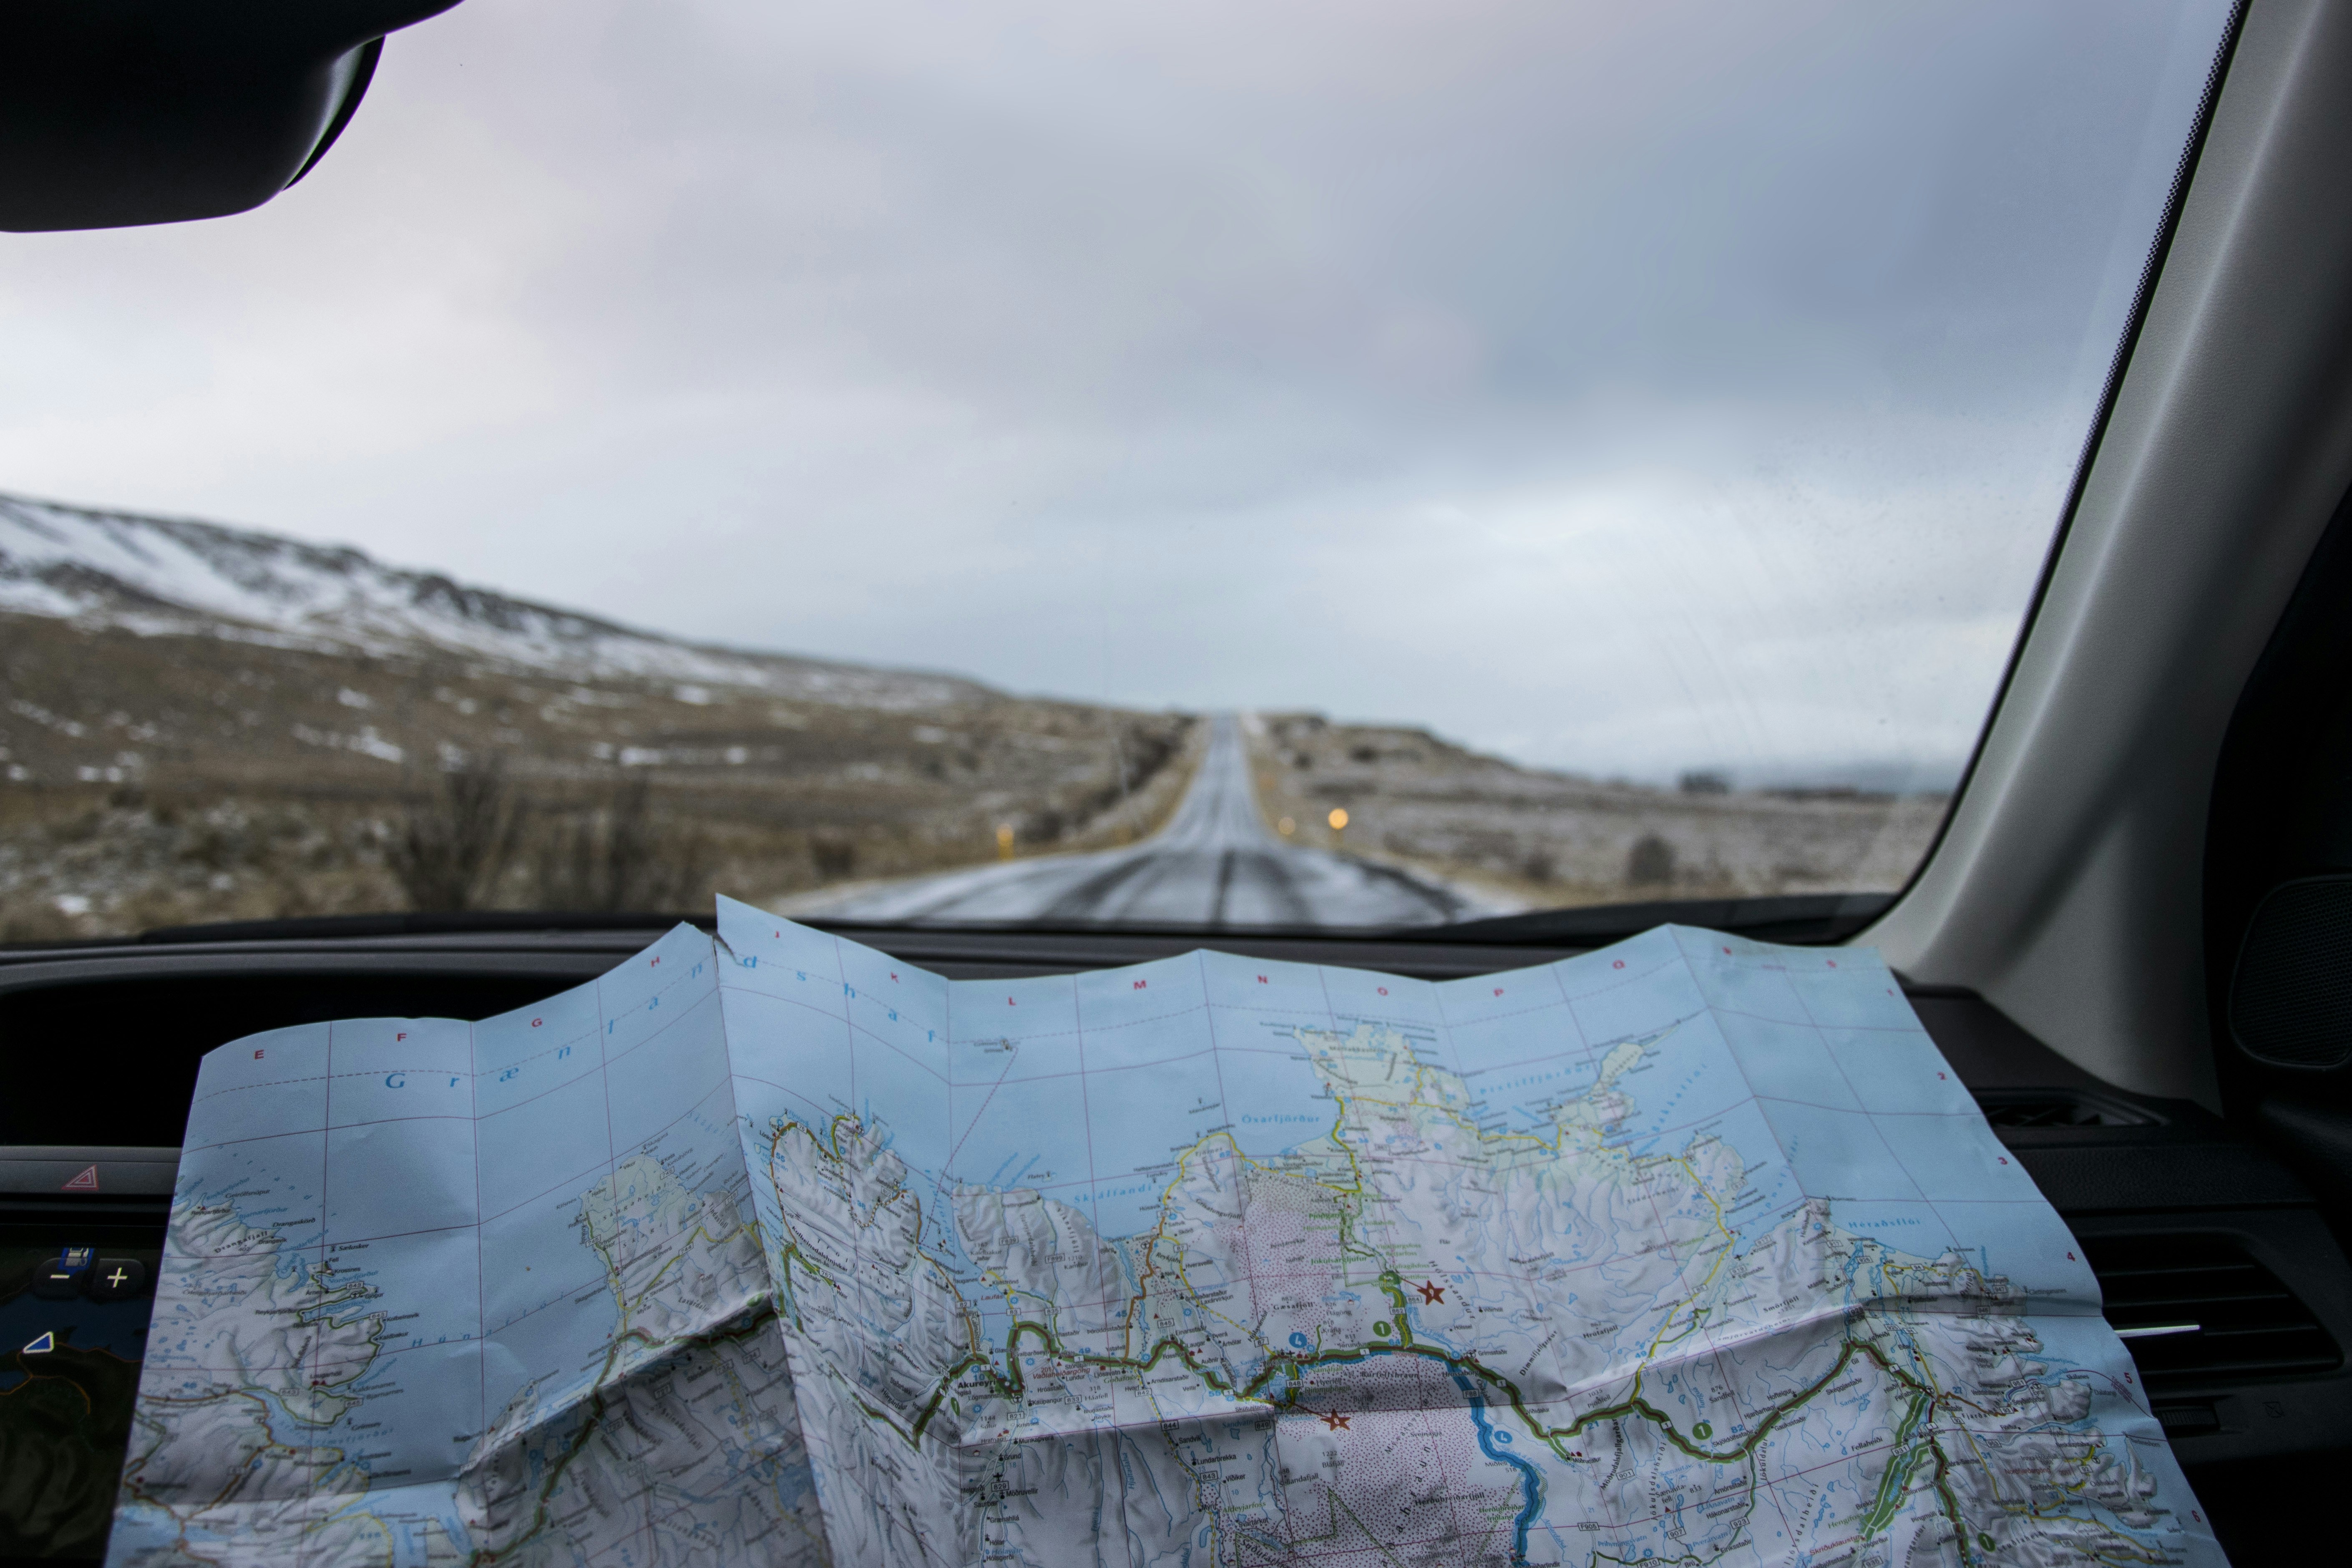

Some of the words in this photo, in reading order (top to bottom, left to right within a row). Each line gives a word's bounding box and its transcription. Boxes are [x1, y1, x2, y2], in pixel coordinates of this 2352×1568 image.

[650, 956, 660, 967] H
[890, 973, 899, 983] K
[1258, 975, 1268, 984] N
[1133, 980, 1147, 990] M
[1494, 988, 1504, 998] P
[1008, 997, 1016, 1007] L
[531, 1018, 543, 1027] G
[397, 1033, 407, 1042] F
[254, 1050, 264, 1059] E
[1937, 1072, 1947, 1081] 2
[1242, 1114, 1320, 1124] Öxarfjörður
[1998, 1157, 2008, 1165] 3
[1074, 1183, 1152, 1203] Skjálfandi
[272, 1218, 315, 1228] Drangaskörð
[214, 1231, 268, 1253] Drangafjall
[681, 1245, 692, 1253] 744
[2067, 1252, 2076, 1262] 4
[1274, 1302, 1313, 1310] Gæsafjöll
[1087, 1325, 1126, 1334] Þóroddsstaður
[2124, 1372, 2133, 1384] 5
[958, 1380, 996, 1388] Akureyri
[1826, 1377, 1862, 1395] Skeggjastaðir
[1588, 1389, 1603, 1397] 1035
[1709, 1390, 1735, 1403] Sandfell
[1767, 1388, 1792, 1401] Hofteigur
[881, 1388, 908, 1410] Hörgárdalur
[1033, 1397, 1063, 1405] Kaupangur
[1840, 1393, 1869, 1407] Sandvatn
[1744, 1405, 1776, 1420] Hjarðarhagi
[1223, 1420, 1253, 1428] Sandvatn
[1587, 1421, 1599, 1430] 21
[1774, 1416, 1806, 1431] Gauksstaðir
[1698, 1425, 1706, 1437] 1
[1731, 1425, 1743, 1433] 82
[1019, 1435, 1054, 1444] Munkaþverá
[1712, 1429, 1753, 1447] Skjöldólfsstaðir
[1851, 1437, 1883, 1451] Fellaheiði
[1197, 1455, 1236, 1465] Lundarbrekka
[1279, 1473, 1319, 1487] Sellandafjall
[1006, 1488, 1038, 1497] Möðruvellir
[1714, 1480, 1748, 1495] Arnórsstaðir
[974, 1500, 999, 1508] Saurbær
[1223, 1502, 1266, 1513] Aldeyjarfoss
[1708, 1497, 1735, 1510] Ánavatn
[1856, 1500, 1877, 1510] Brekka
[1706, 1501, 1746, 1519] Hákonarstaðir
[1828, 1513, 1863, 1529] Hengifoss
[2191, 1510, 2201, 1523] 6
[1239, 1518, 1268, 1526] Svartárkot
[1809, 1535, 1862, 1555] Skriðuklaustur
[1866, 1559, 1879, 1567] 935
